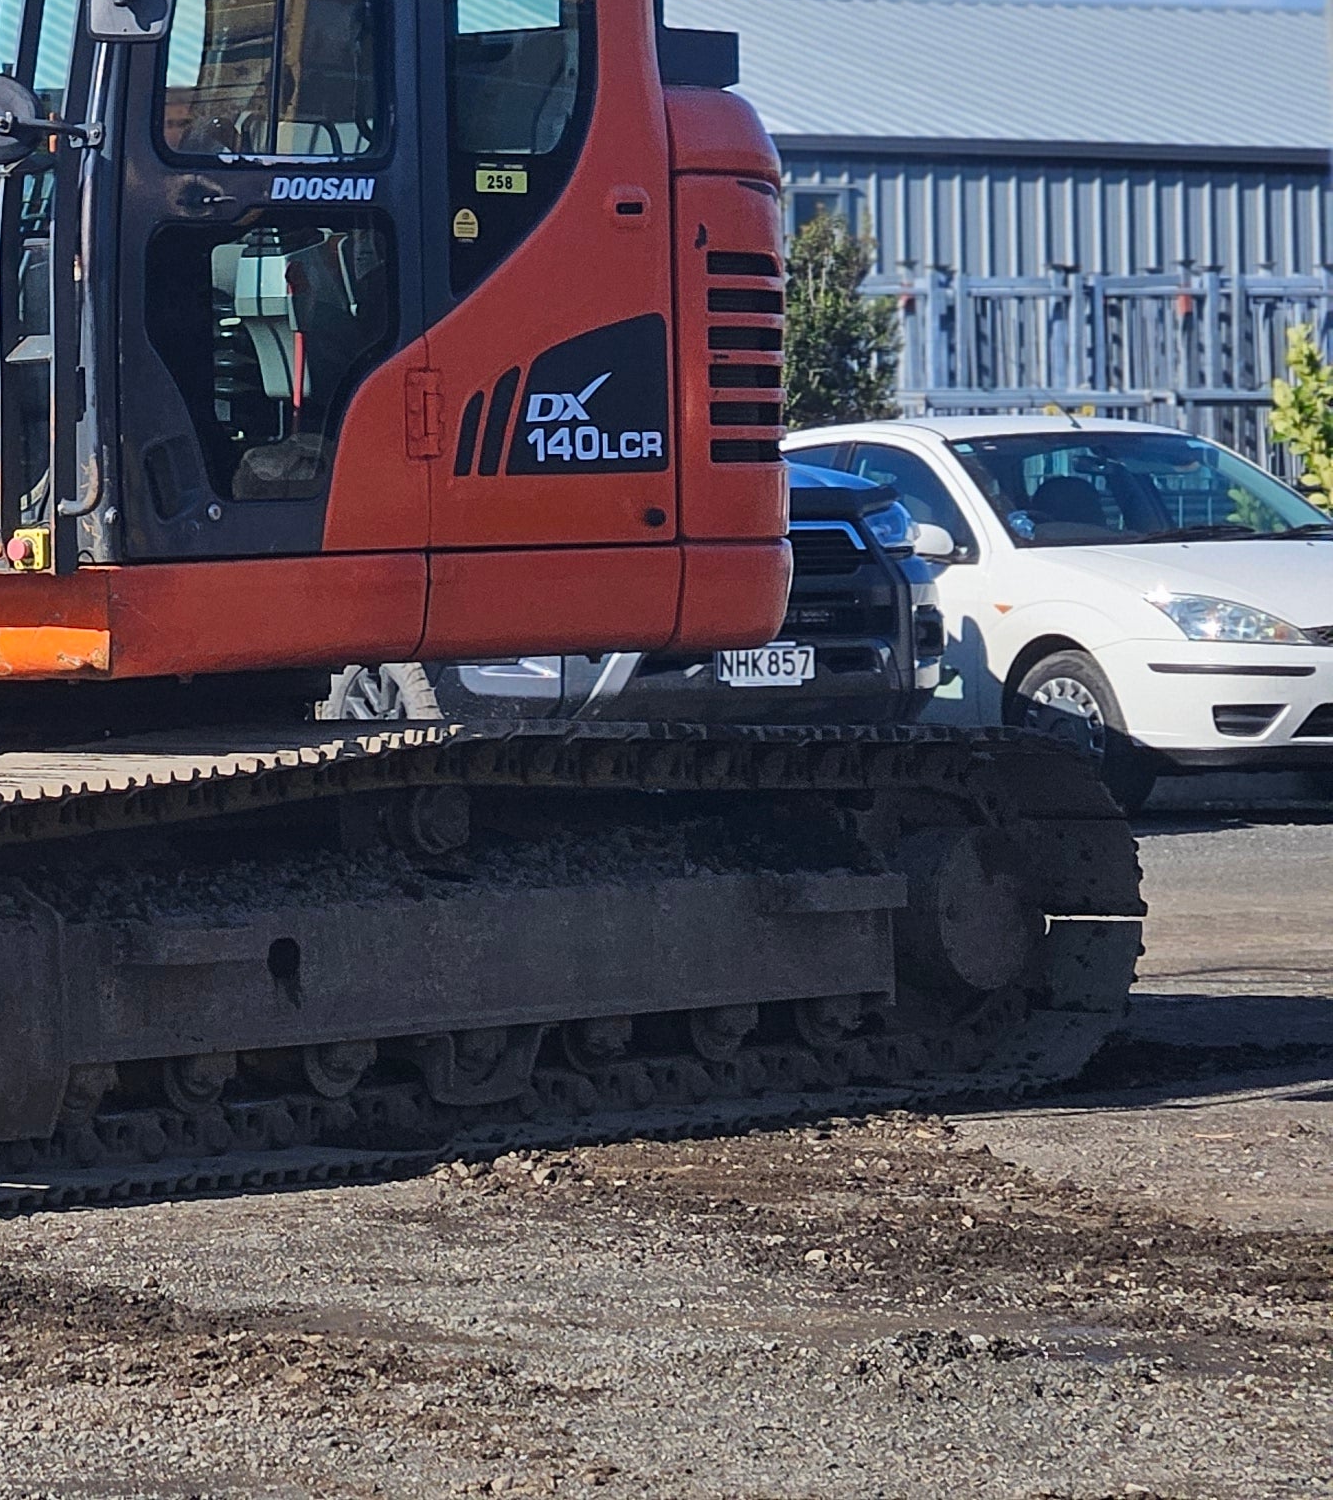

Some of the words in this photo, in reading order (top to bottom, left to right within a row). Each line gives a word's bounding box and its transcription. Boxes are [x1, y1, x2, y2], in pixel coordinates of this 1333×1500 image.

[271, 177, 375, 200] DOOSAN
[487, 175, 513, 190] 258
[526, 372, 612, 422] DX
[527, 426, 662, 462] 140LCR
[719, 650, 811, 678] NHK857
